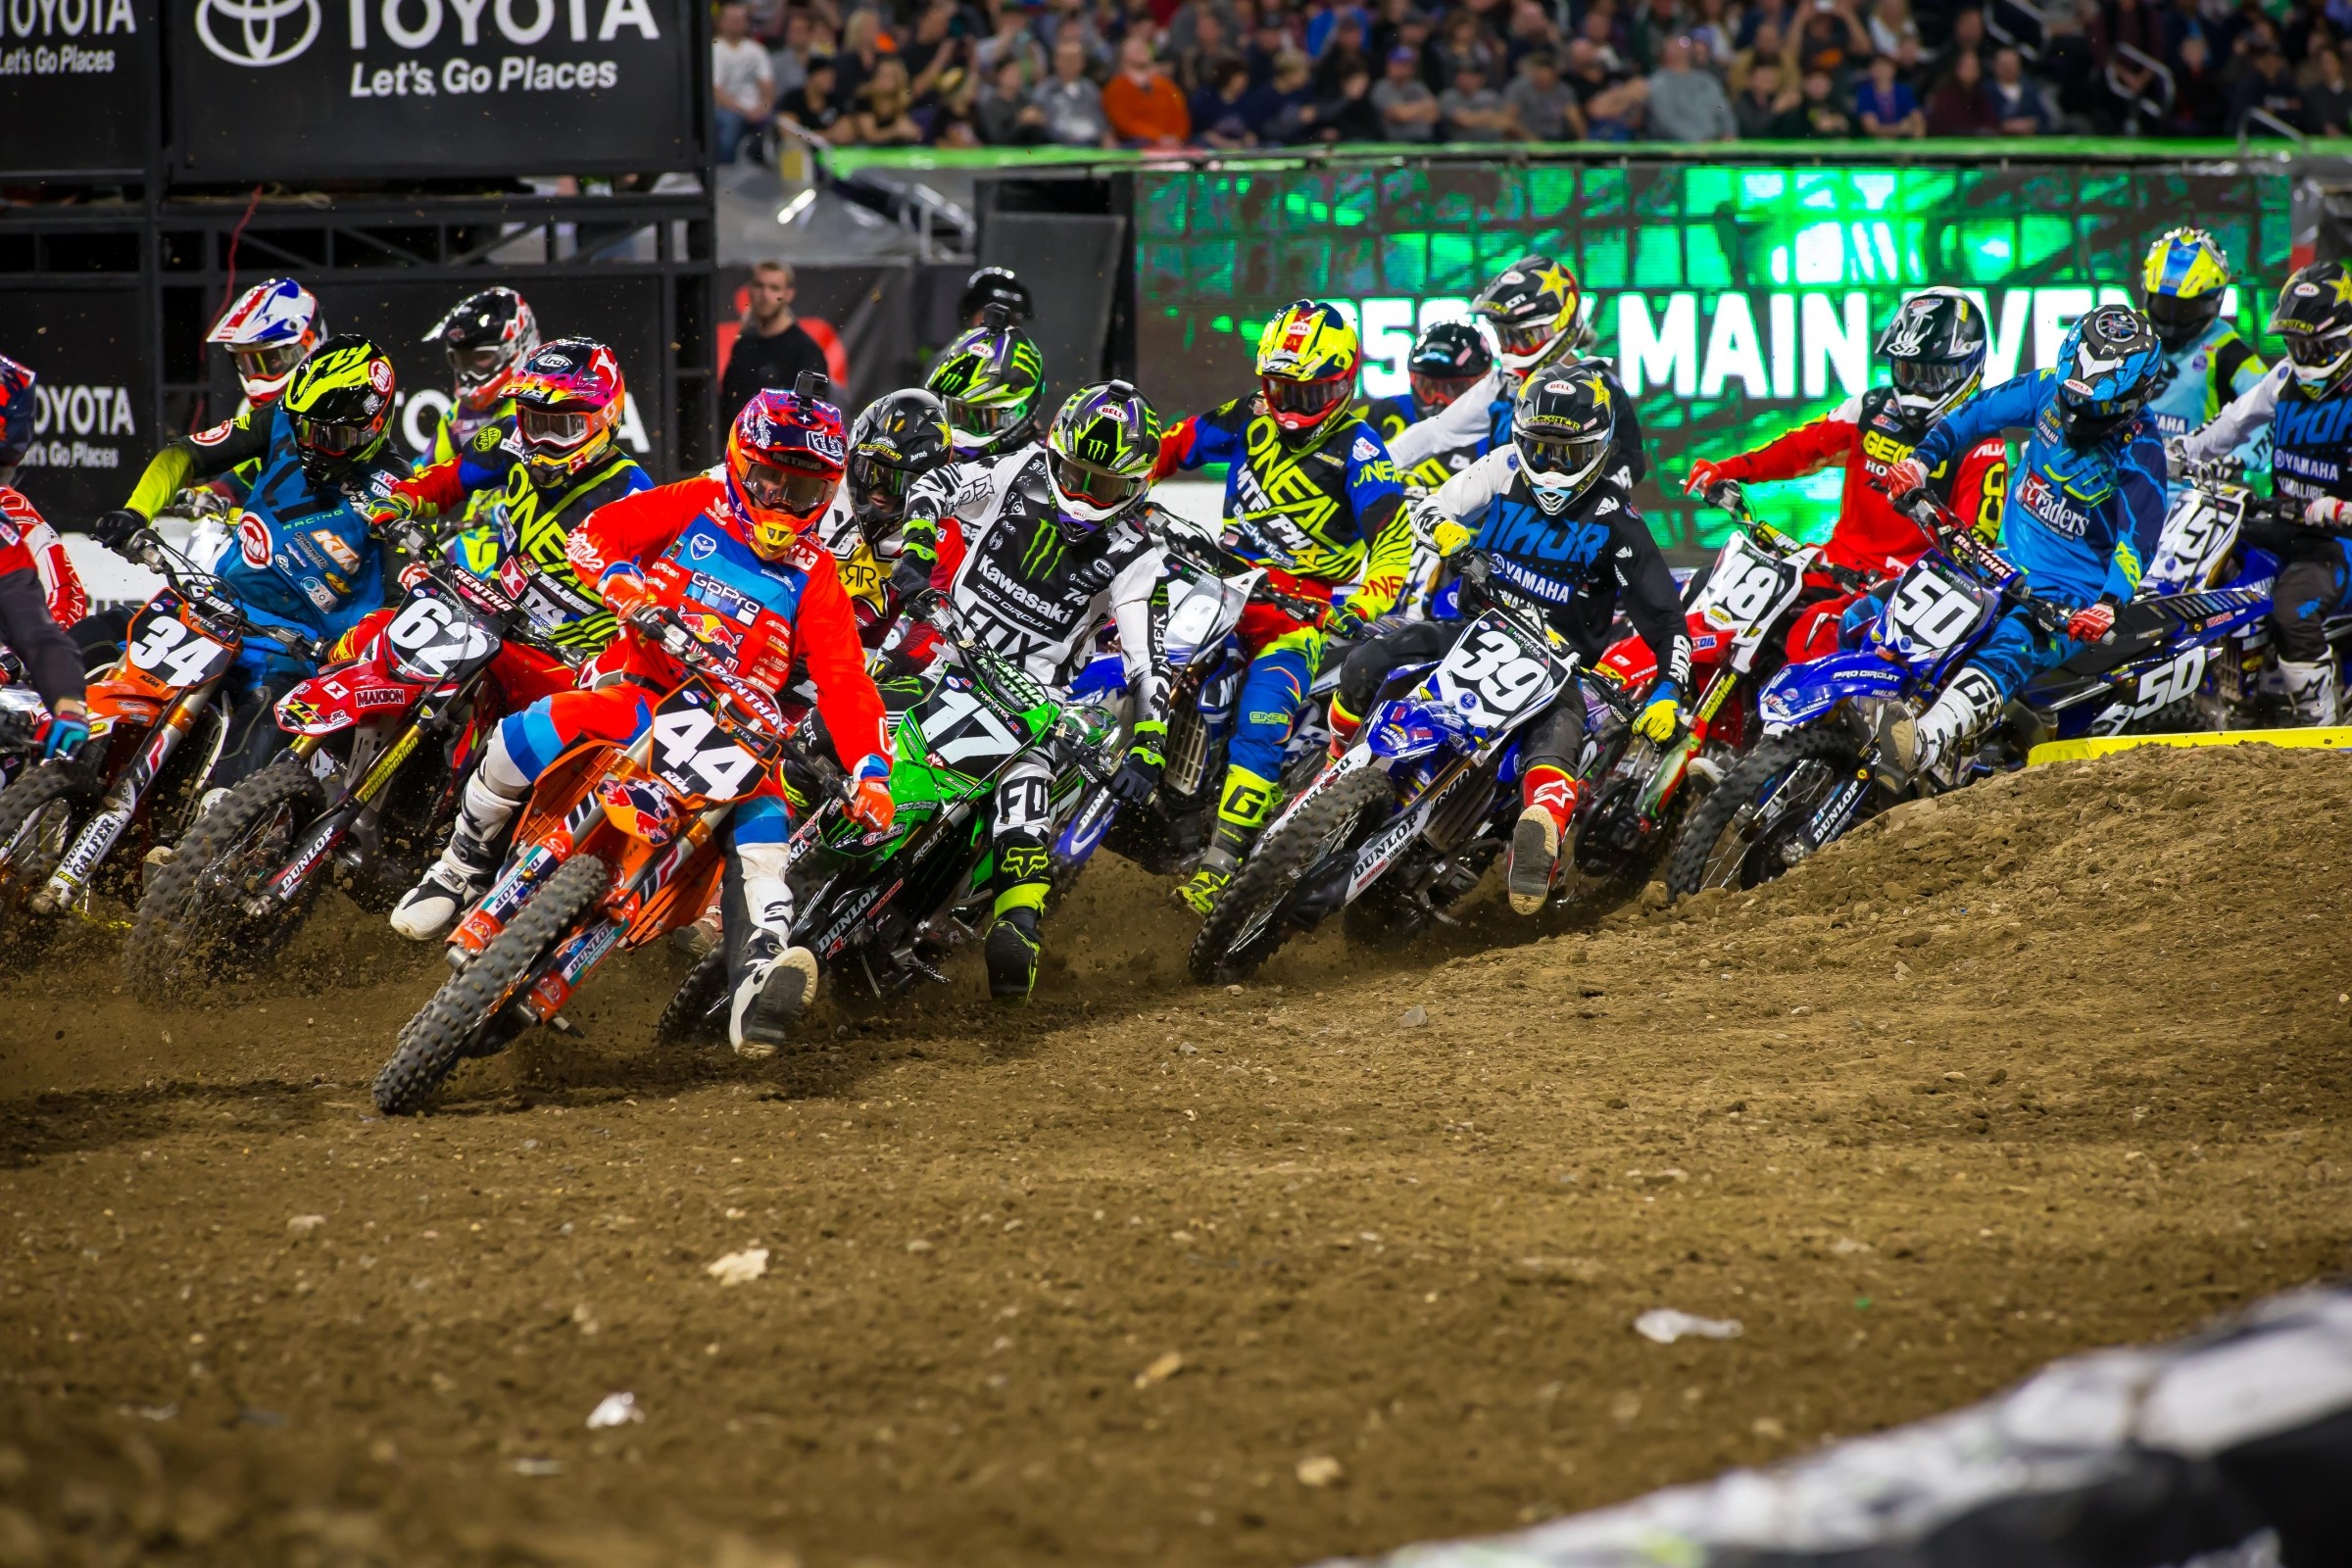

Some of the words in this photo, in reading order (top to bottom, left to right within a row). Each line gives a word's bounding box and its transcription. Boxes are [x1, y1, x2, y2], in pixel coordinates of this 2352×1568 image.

[0, 0, 136, 37] OYOTA
[350, 0, 661, 49] TOYOTA
[33, 44, 59, 74] Go
[59, 43, 116, 74] Places
[351, 60, 437, 97] Let's
[442, 58, 491, 93] Go
[498, 56, 618, 91] Places
[970, 343, 992, 356] BELL
[1618, 291, 1869, 398] MAIN
[298, 342, 372, 398] FLY
[1549, 383, 1571, 392] BELL
[2067, 379, 2091, 394] BELL
[1100, 406, 1124, 420] BELL
[1237, 462, 1271, 512] MTF
[2285, 452, 2339, 482] YAMAHA
[282, 509, 345, 531] RACING
[705, 507, 728, 526] adidas
[1478, 499, 1611, 569] THOR
[1266, 513, 1331, 570] PHX
[453, 567, 514, 612] RENTHA
[976, 554, 1074, 624] Kawasaki
[977, 583, 1001, 603] PRO
[1000, 601, 1054, 631] CIRCUIT
[1061, 586, 1090, 606] 74
[1505, 561, 1570, 604] YAMAHA
[1707, 552, 1786, 621] 18
[1892, 568, 1982, 650] 50
[129, 614, 224, 687] 34
[387, 597, 488, 672] 62
[139, 673, 161, 688] KTM
[1448, 631, 1555, 712] 39
[1833, 670, 1859, 679] PRO
[1858, 669, 1900, 682] CIRCUIT
[2133, 647, 2205, 721] 50
[919, 687, 1022, 765] 17
[652, 707, 759, 801] 44
[1078, 786, 1111, 831] DUN
[1812, 779, 1860, 844] DUNLOP
[72, 817, 117, 879] GALFER
[279, 825, 335, 893] DUNLOP
[1351, 813, 1419, 880] DUNLOP
